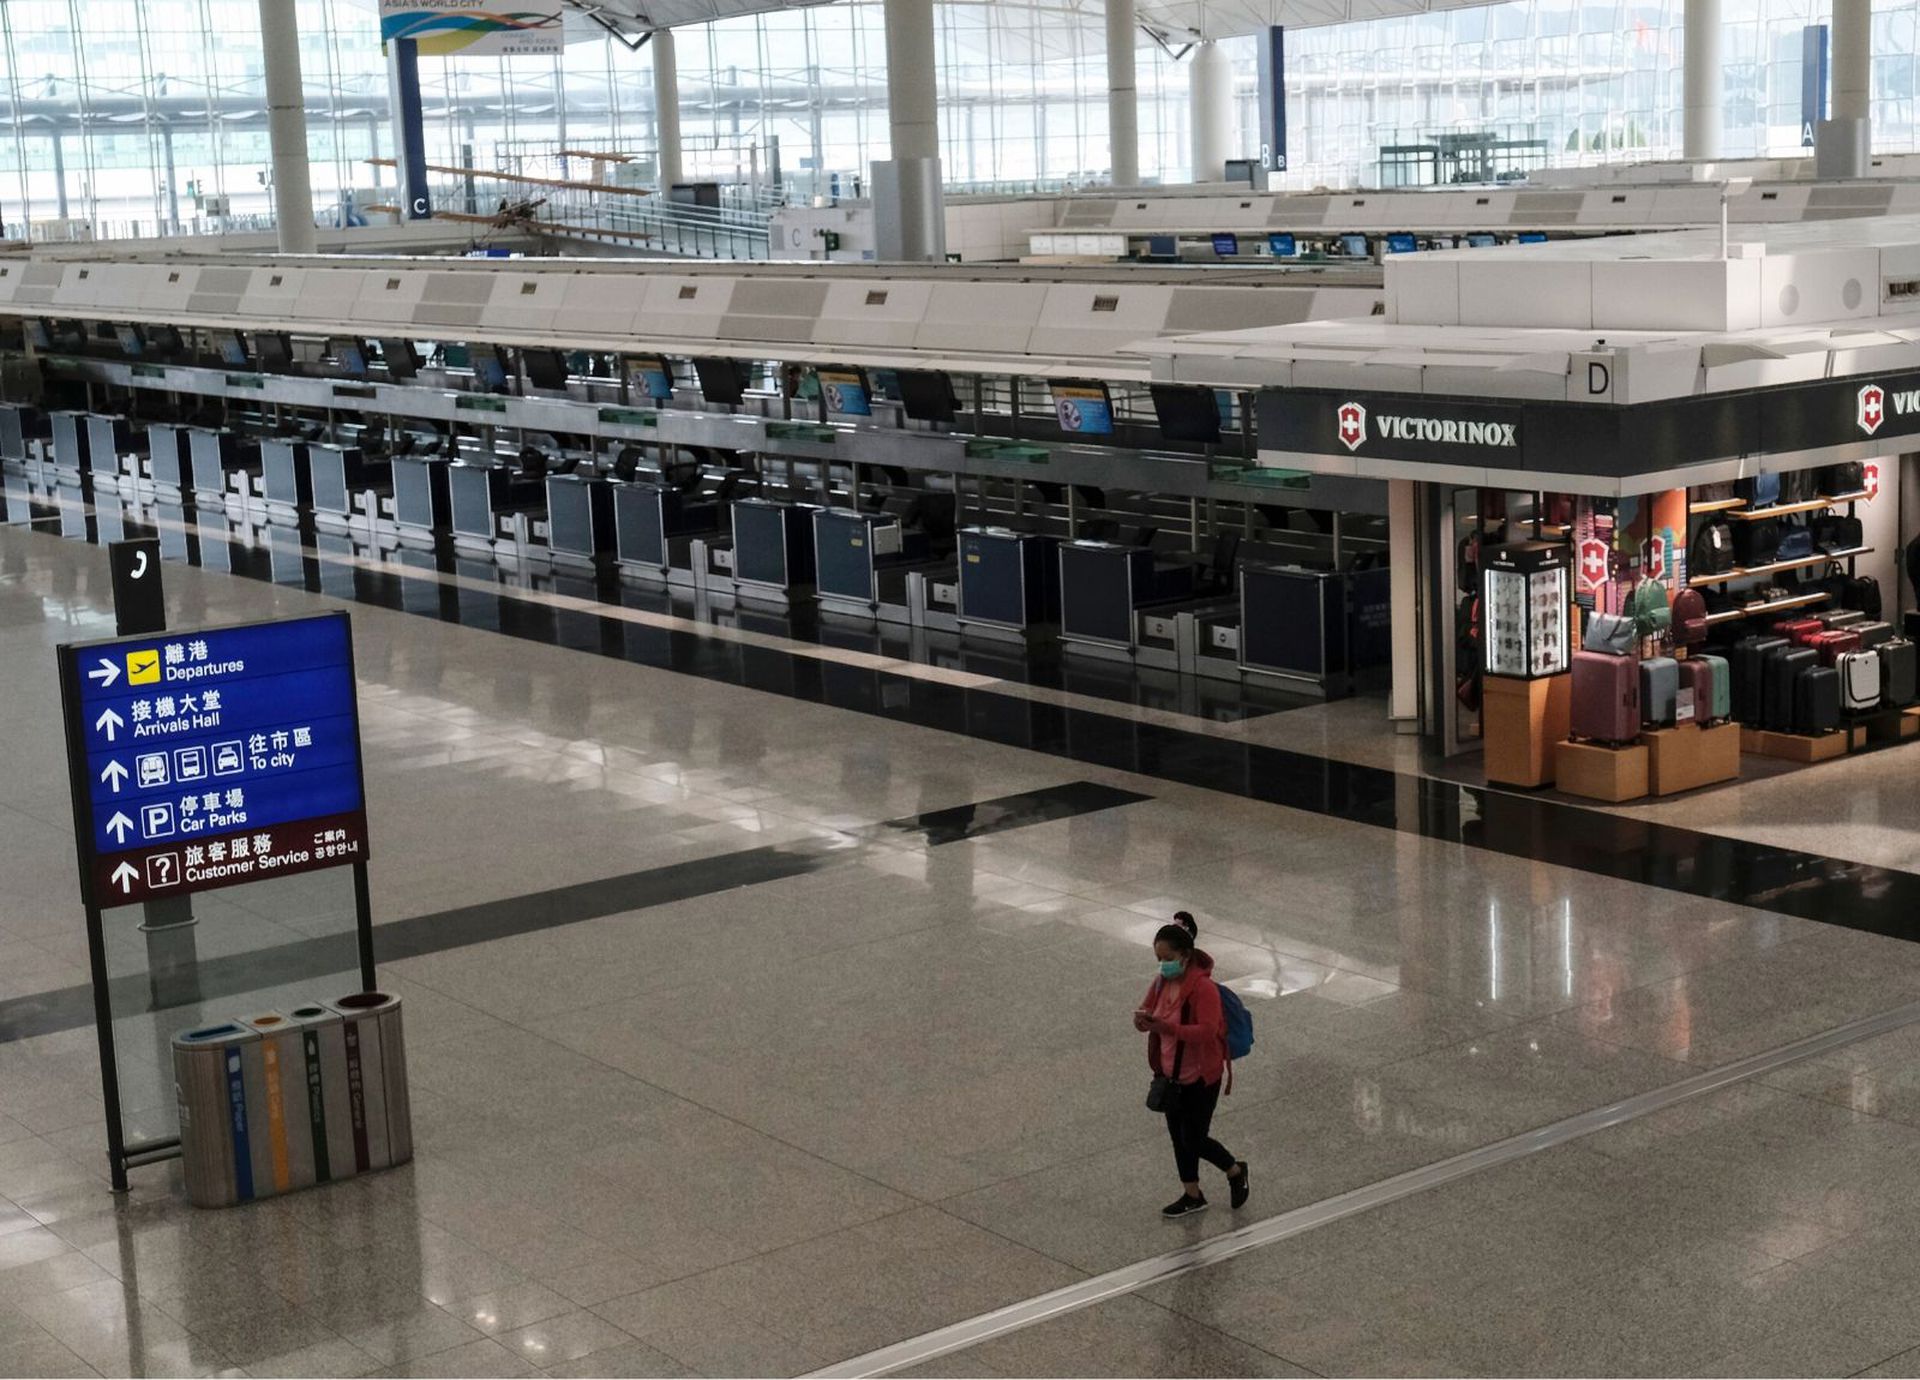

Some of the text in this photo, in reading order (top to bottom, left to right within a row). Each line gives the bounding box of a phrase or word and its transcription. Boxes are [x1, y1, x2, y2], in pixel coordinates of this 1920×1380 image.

[421, 0, 458, 8] WORLD
[460, 0, 483, 8] CITY
[1802, 121, 1814, 145] A
[1262, 143, 1270, 168] B
[1277, 154, 1285, 168] B
[413, 198, 426, 214] C
[1589, 362, 1609, 394] D
[1375, 415, 1517, 447] VICTORINOX
[164, 640, 208, 665] 離港
[166, 660, 244, 681] Departures
[131, 690, 221, 722] 接機大堂
[134, 712, 220, 738] Arrivals Hall
[248, 727, 312, 754] 往市區
[249, 753, 295, 770] To city
[179, 788, 244, 817] 停車場
[148, 807, 169, 835] P
[180, 811, 247, 833] Car Parks
[185, 833, 272, 867] 旅客服務
[186, 850, 309, 882] Customer Service
